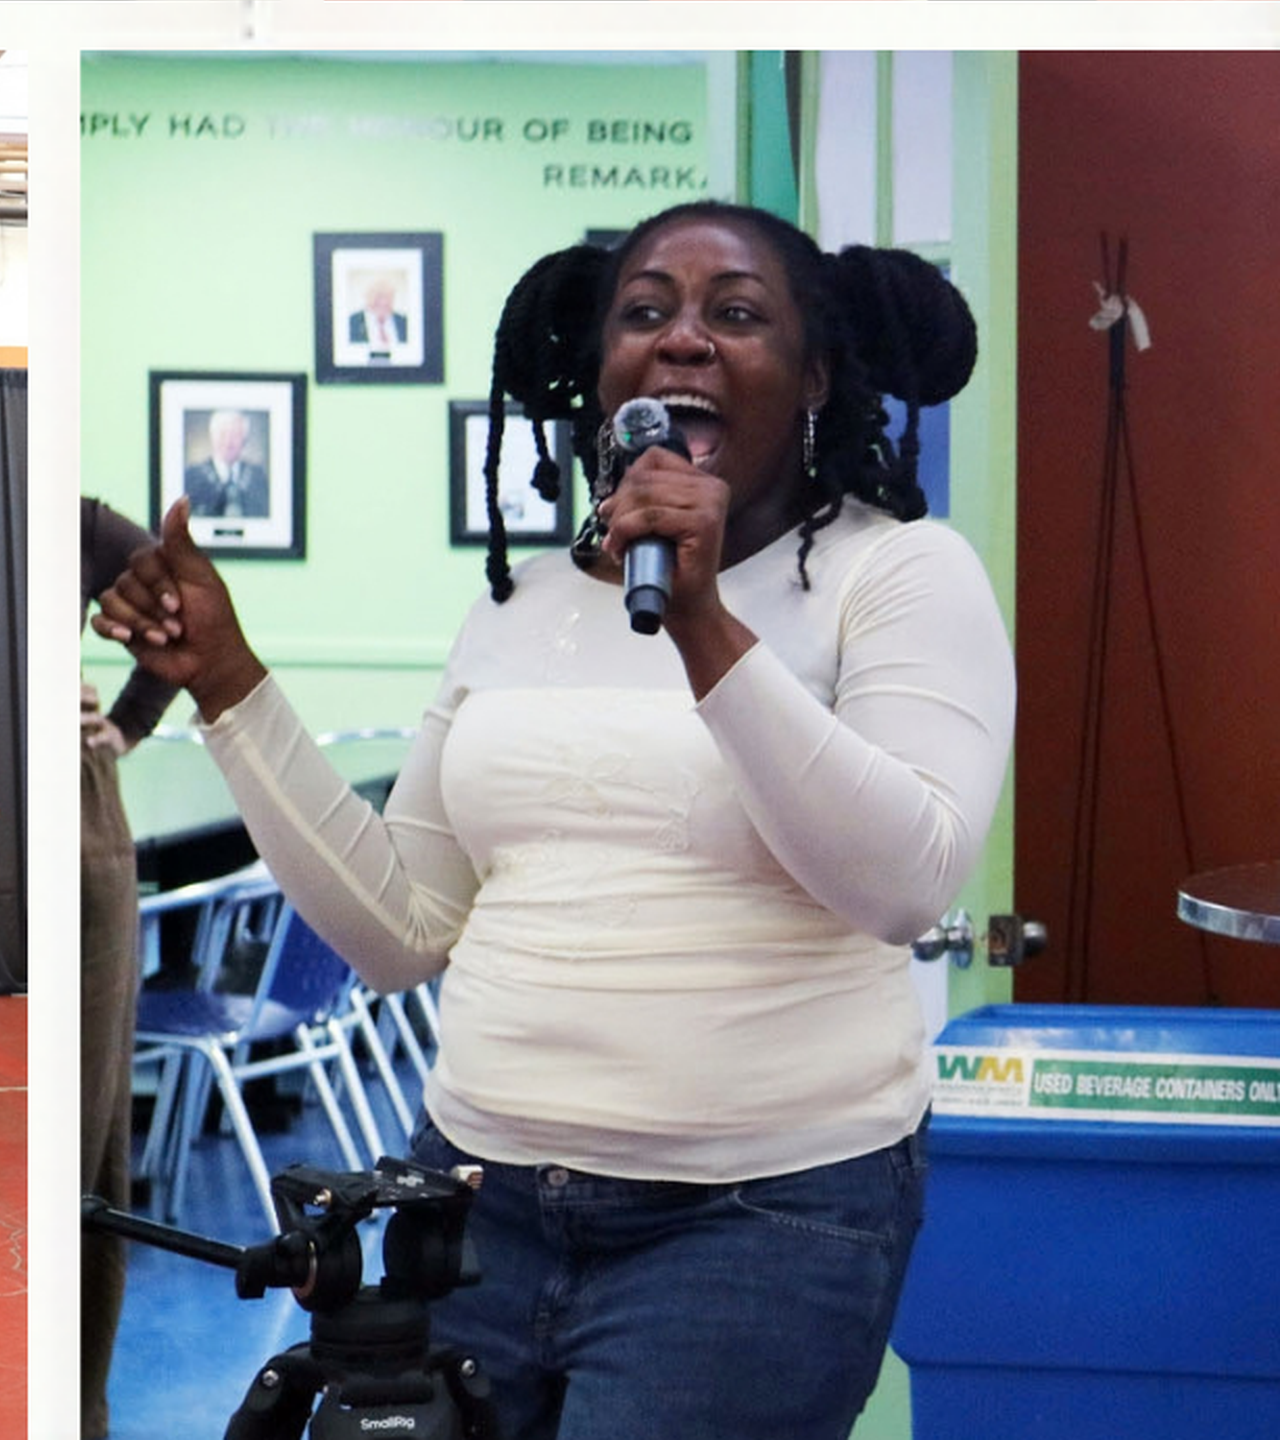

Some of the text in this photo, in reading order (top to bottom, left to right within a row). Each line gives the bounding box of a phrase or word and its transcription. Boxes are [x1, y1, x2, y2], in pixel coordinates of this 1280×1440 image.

[169, 113, 246, 138] HAD
[522, 118, 569, 143] OF
[587, 119, 693, 144] BEING
[937, 1054, 1024, 1083] WM
[1034, 1073, 1073, 1095] USED
[1076, 1074, 1152, 1099] BEVERAGE
[1155, 1077, 1246, 1102] CONTAINERS
